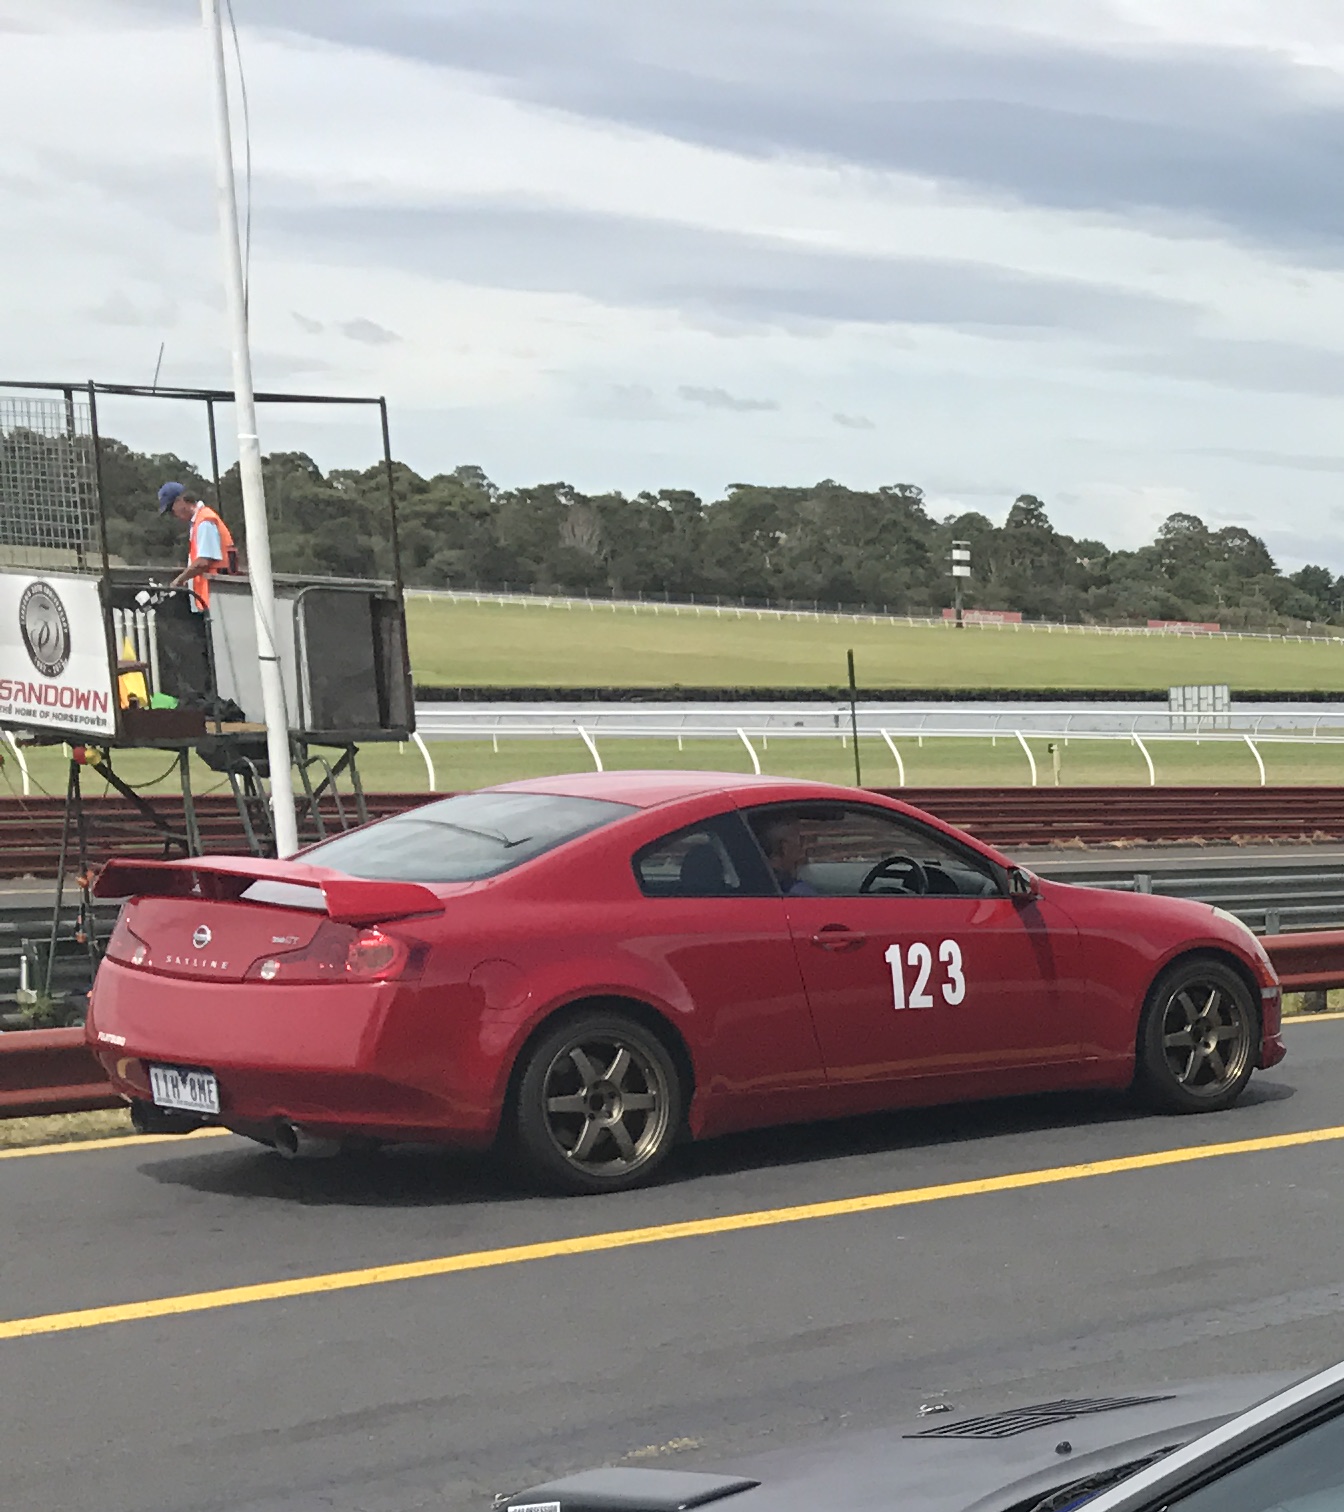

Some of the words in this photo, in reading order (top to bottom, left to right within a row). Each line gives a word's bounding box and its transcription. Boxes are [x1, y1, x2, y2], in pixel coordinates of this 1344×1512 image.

[0, 679, 108, 714] SANDOWN
[15, 707, 38, 718] HOME
[39, 710, 50, 719] OF
[52, 712, 107, 727] HORSEPOWER
[884, 938, 967, 1011] 123
